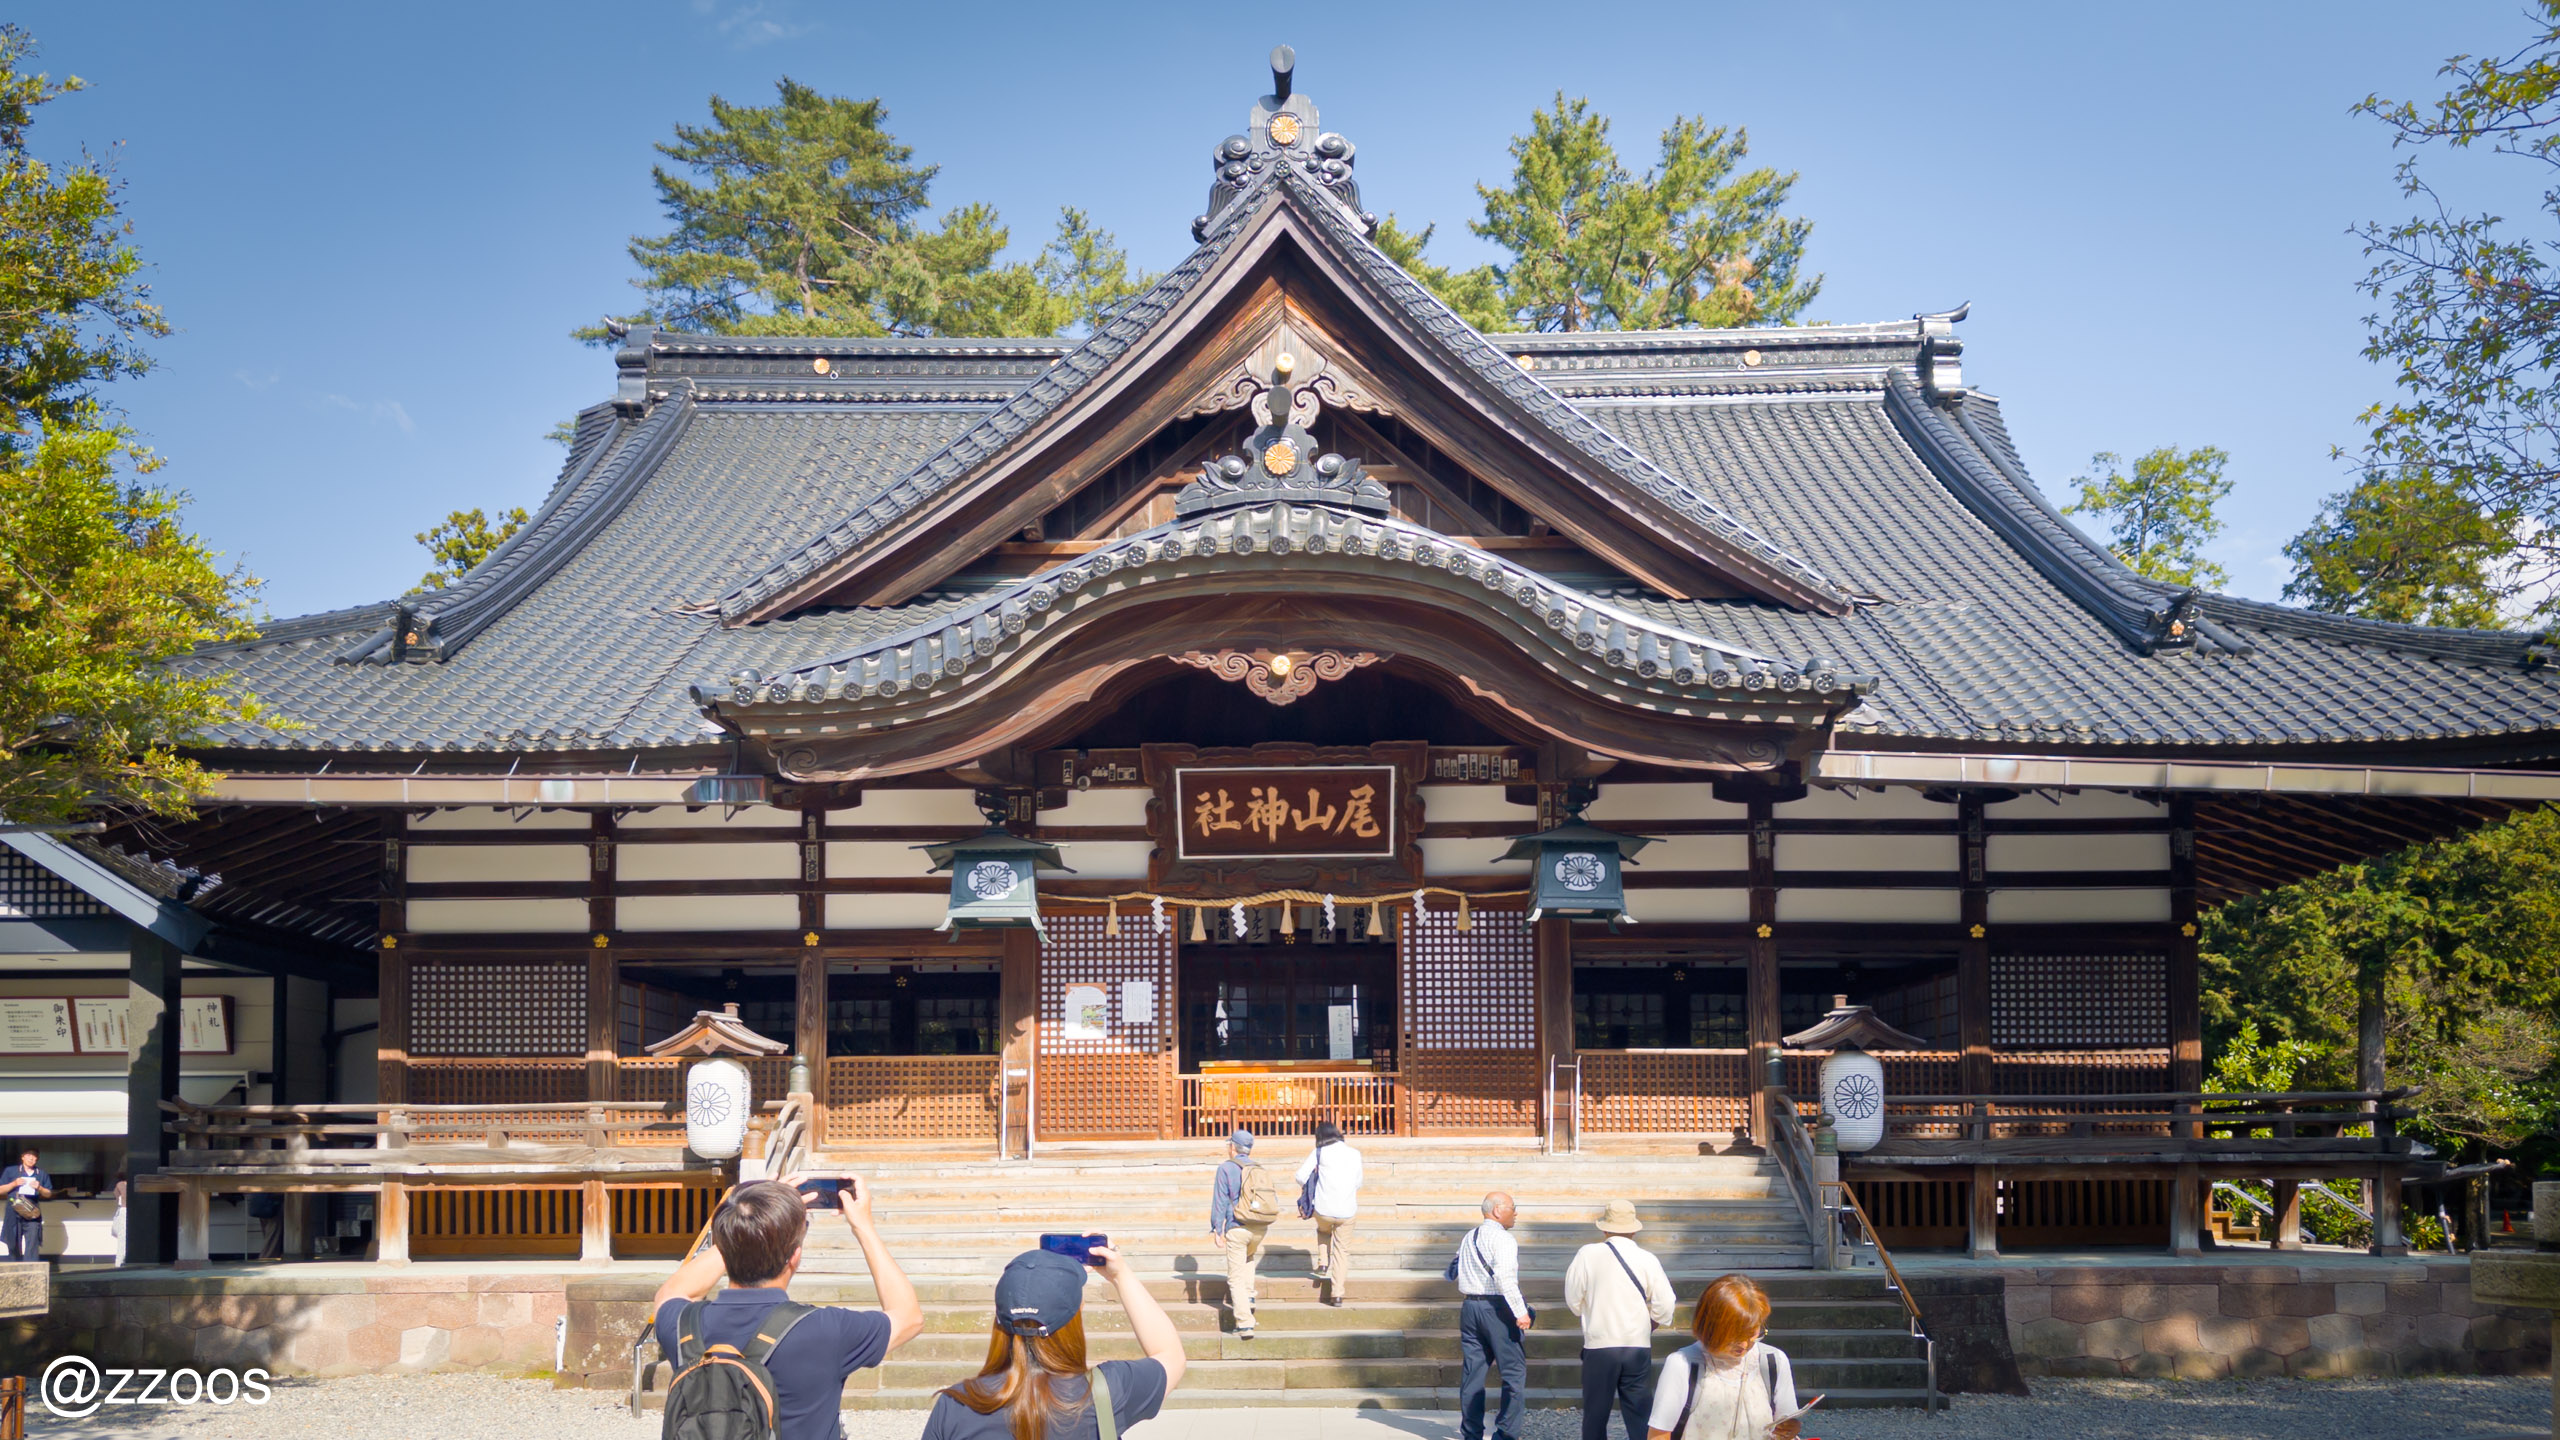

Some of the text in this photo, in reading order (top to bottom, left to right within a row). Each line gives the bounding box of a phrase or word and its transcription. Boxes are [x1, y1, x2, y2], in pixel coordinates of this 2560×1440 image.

[1192, 783, 1381, 844] 尾山神社
[53, 1003, 67, 1038] 御朱印
[207, 1002, 220, 1028] 神札
